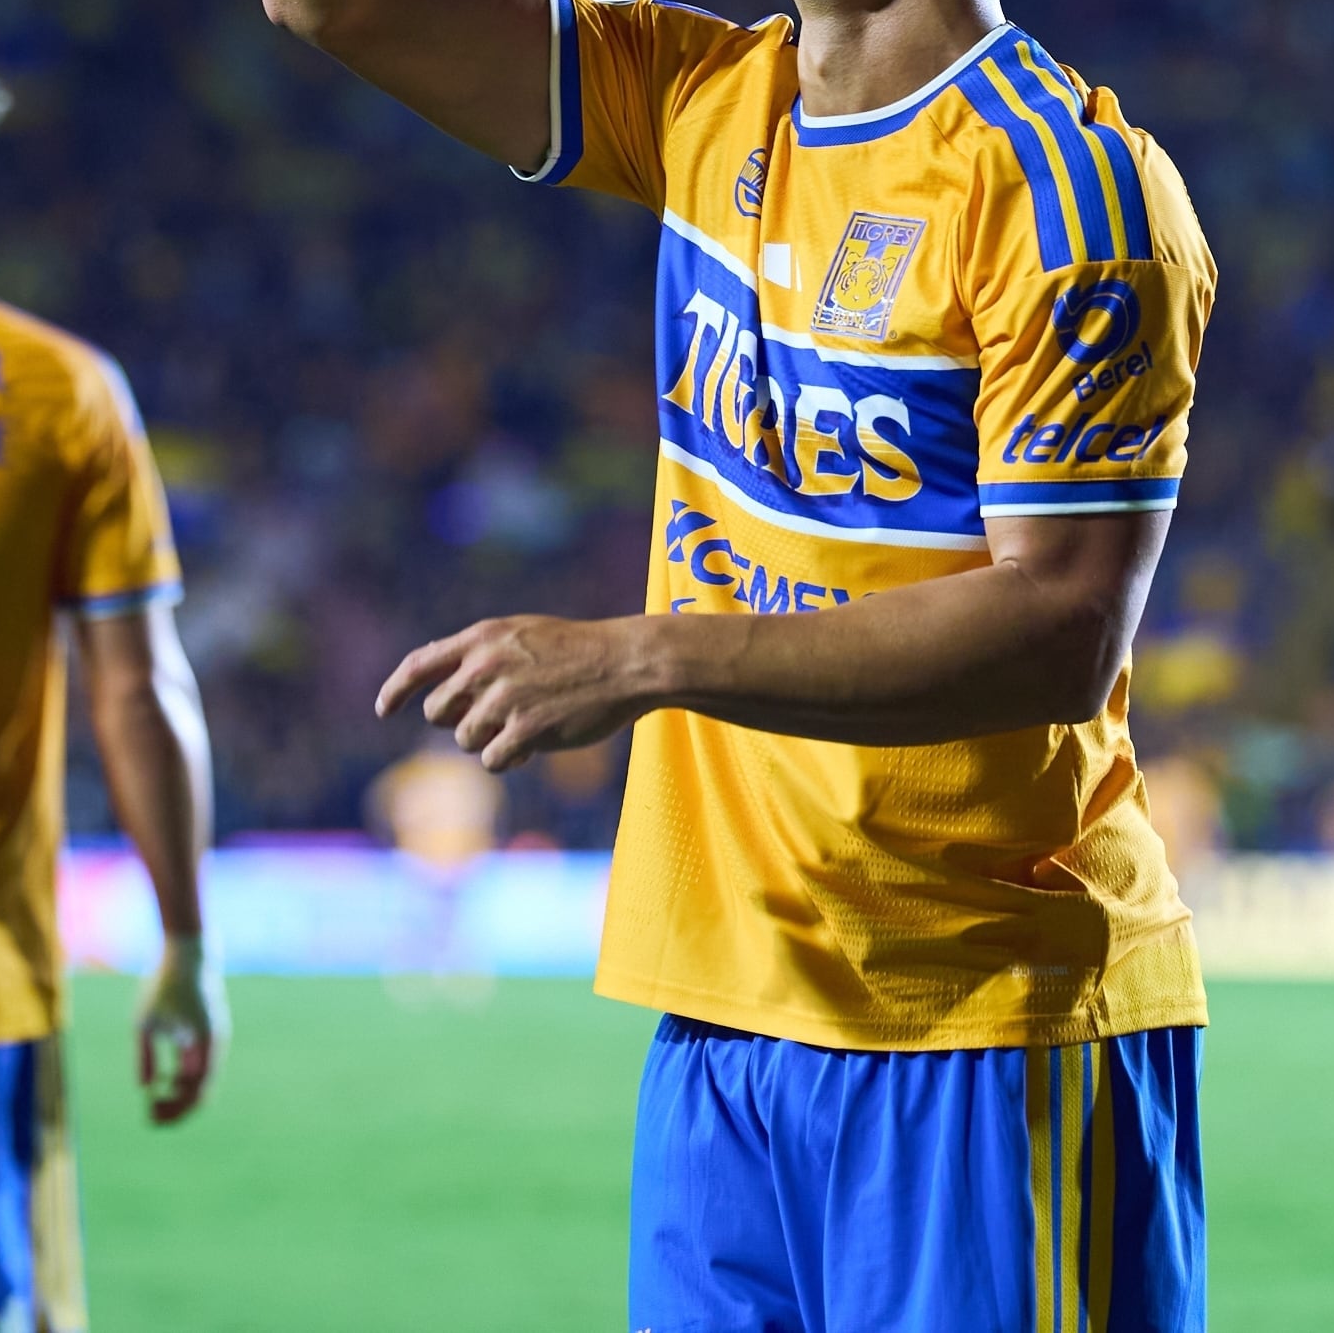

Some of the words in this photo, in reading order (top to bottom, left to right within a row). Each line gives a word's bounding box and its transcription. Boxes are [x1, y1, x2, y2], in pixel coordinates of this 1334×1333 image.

[852, 222, 915, 245] TIGRES
[661, 288, 923, 501] TIGRES
[1072, 340, 1154, 403] Berel
[1002, 411, 1169, 465] telcel
[690, 539, 876, 615] CEME
